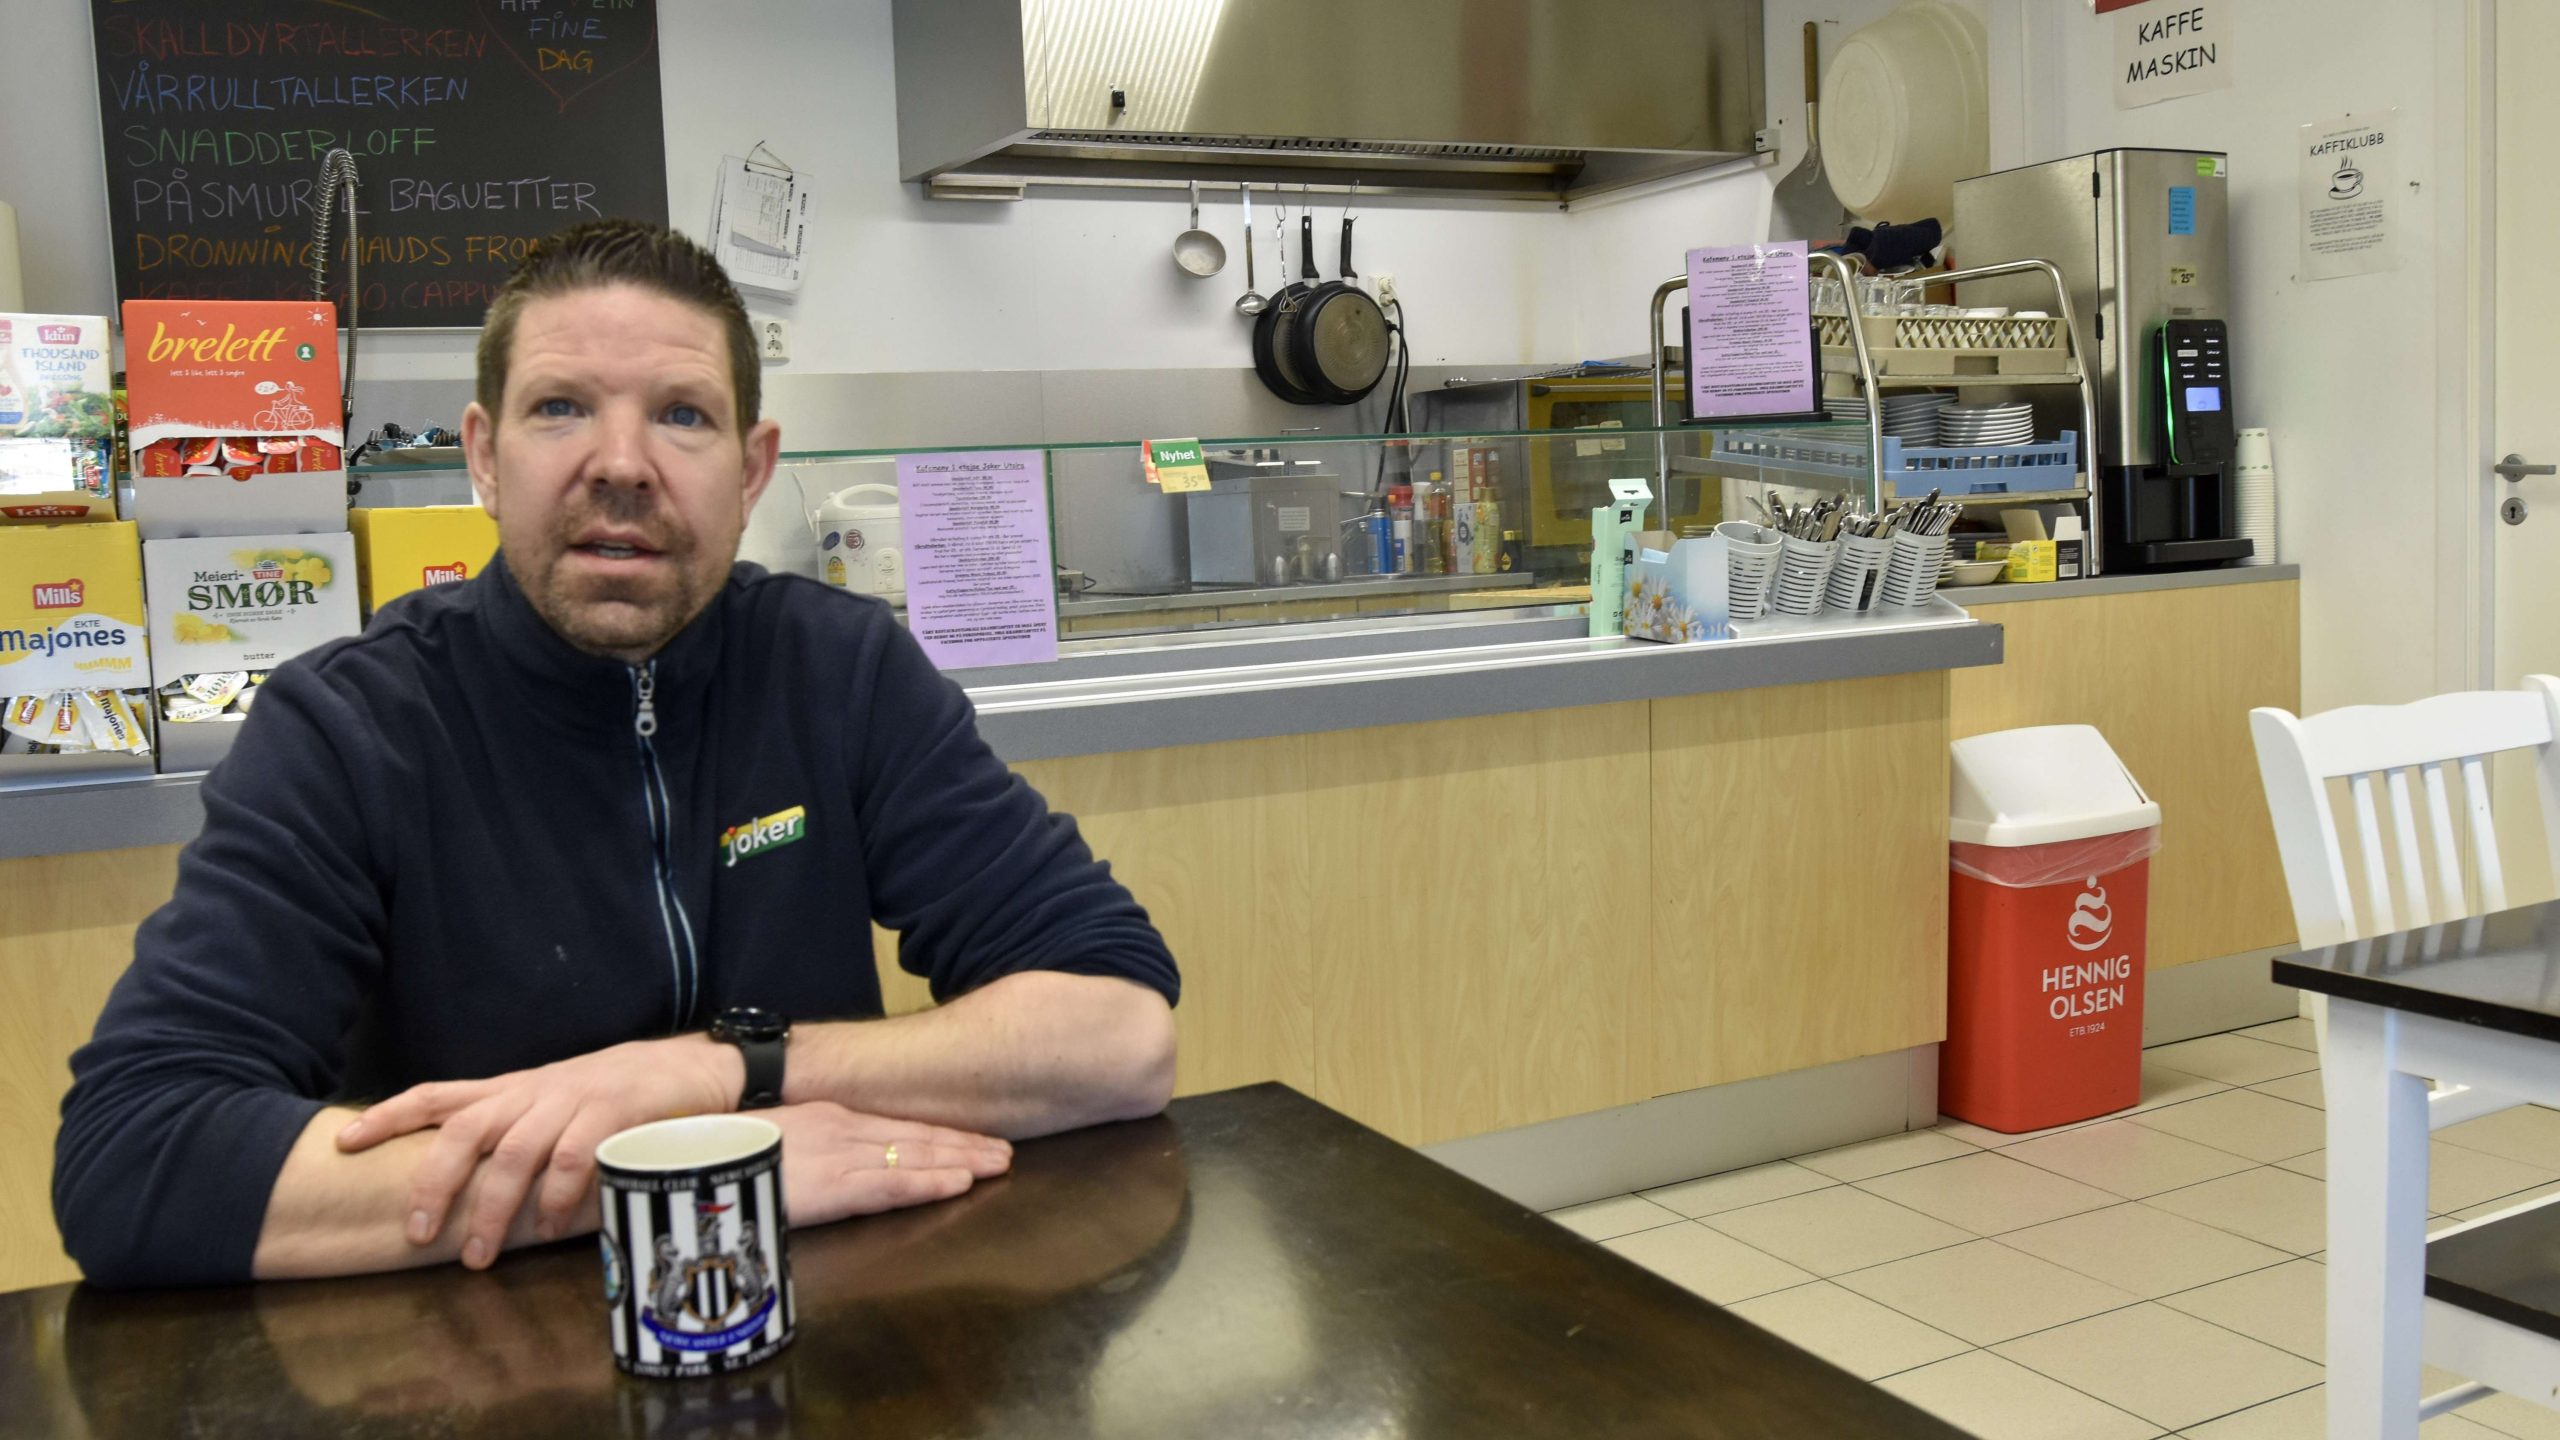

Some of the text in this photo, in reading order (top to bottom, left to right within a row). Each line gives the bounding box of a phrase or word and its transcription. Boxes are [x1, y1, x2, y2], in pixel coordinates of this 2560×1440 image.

[528, 11, 607, 40] FINE
[2139, 8, 2203, 45] KAFFE
[537, 47, 594, 74] DAG
[2127, 43, 2215, 83] MASKIN
[109, 60, 468, 114] VÅRRULLTALLERKEN
[2309, 132, 2385, 157] KAFFIKLUBB
[133, 168, 602, 223] PÅSMURE BAGUETTER
[341, 236, 451, 267] MAUDS
[22, 347, 100, 361] THOUSAND
[147, 321, 288, 362] brelett
[35, 359, 87, 372] ISLAND
[1160, 449, 1196, 464] Nyhet
[193, 570, 244, 582] Meieri-
[254, 570, 281, 578] TINE
[36, 587, 81, 606] Mills
[187, 580, 319, 611] SMØR
[74, 619, 100, 628] EKTE
[0, 627, 126, 657] majones
[243, 651, 275, 661] butter
[727, 816, 800, 867] joker
[2042, 955, 2131, 993] HENNIG
[2050, 984, 2124, 1020] OLSEN
